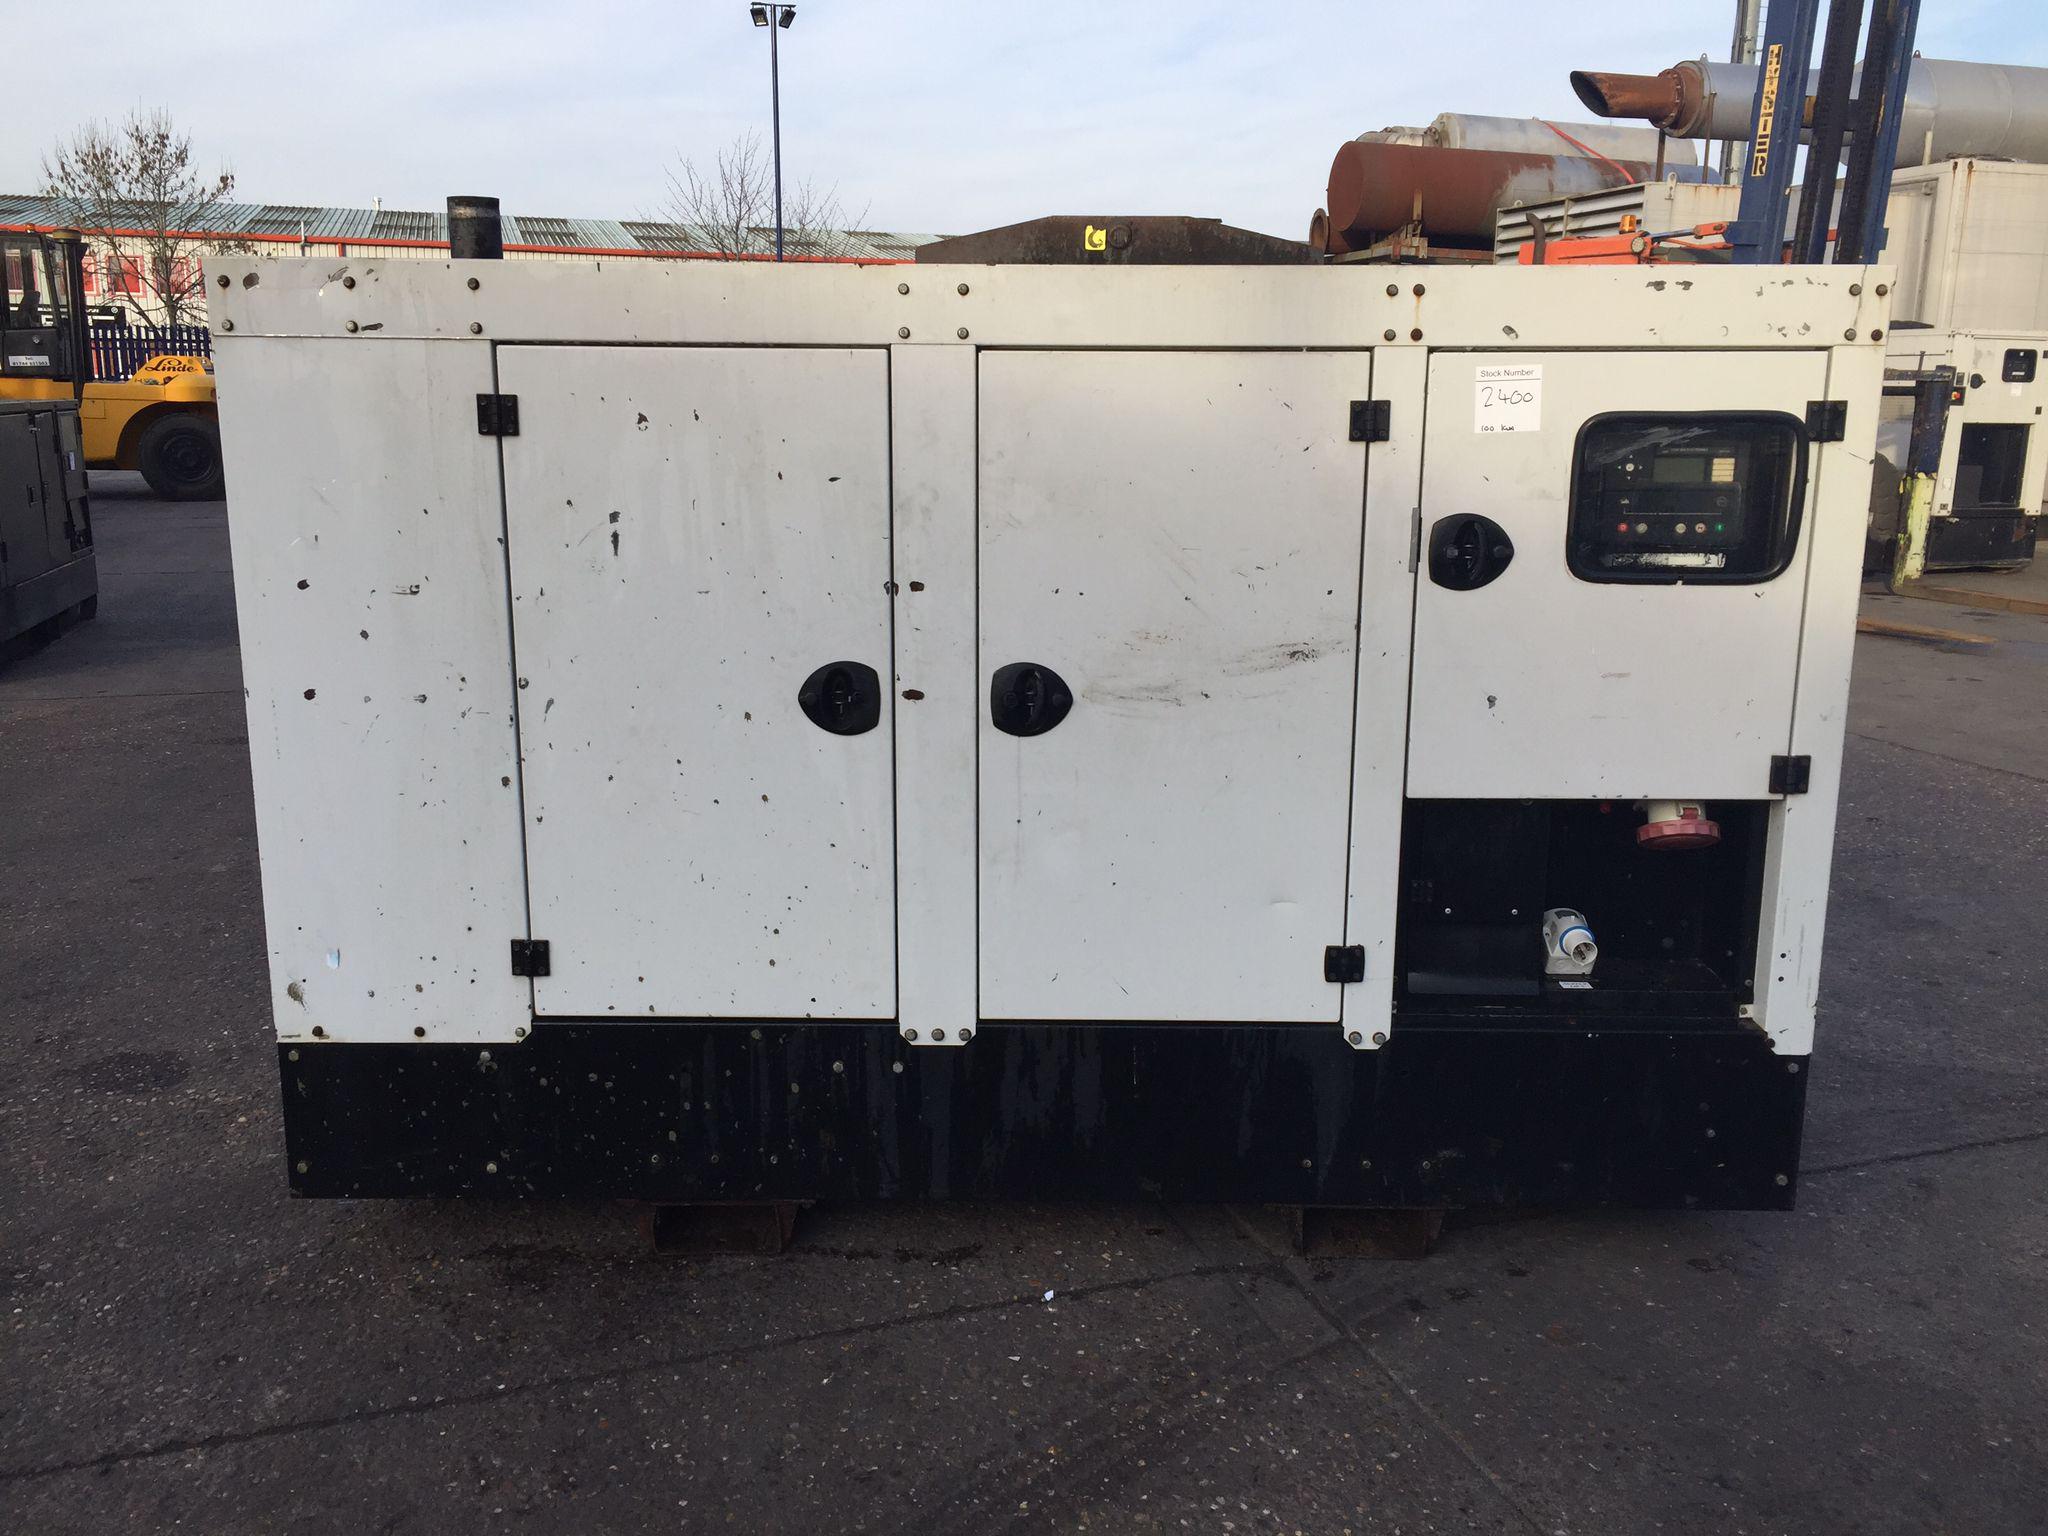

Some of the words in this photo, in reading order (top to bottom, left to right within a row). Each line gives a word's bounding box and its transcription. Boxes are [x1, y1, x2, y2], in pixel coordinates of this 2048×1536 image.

[145, 357, 195, 372] Linde
[1480, 370, 1502, 378] Stock
[1481, 386, 1534, 407] 2400
